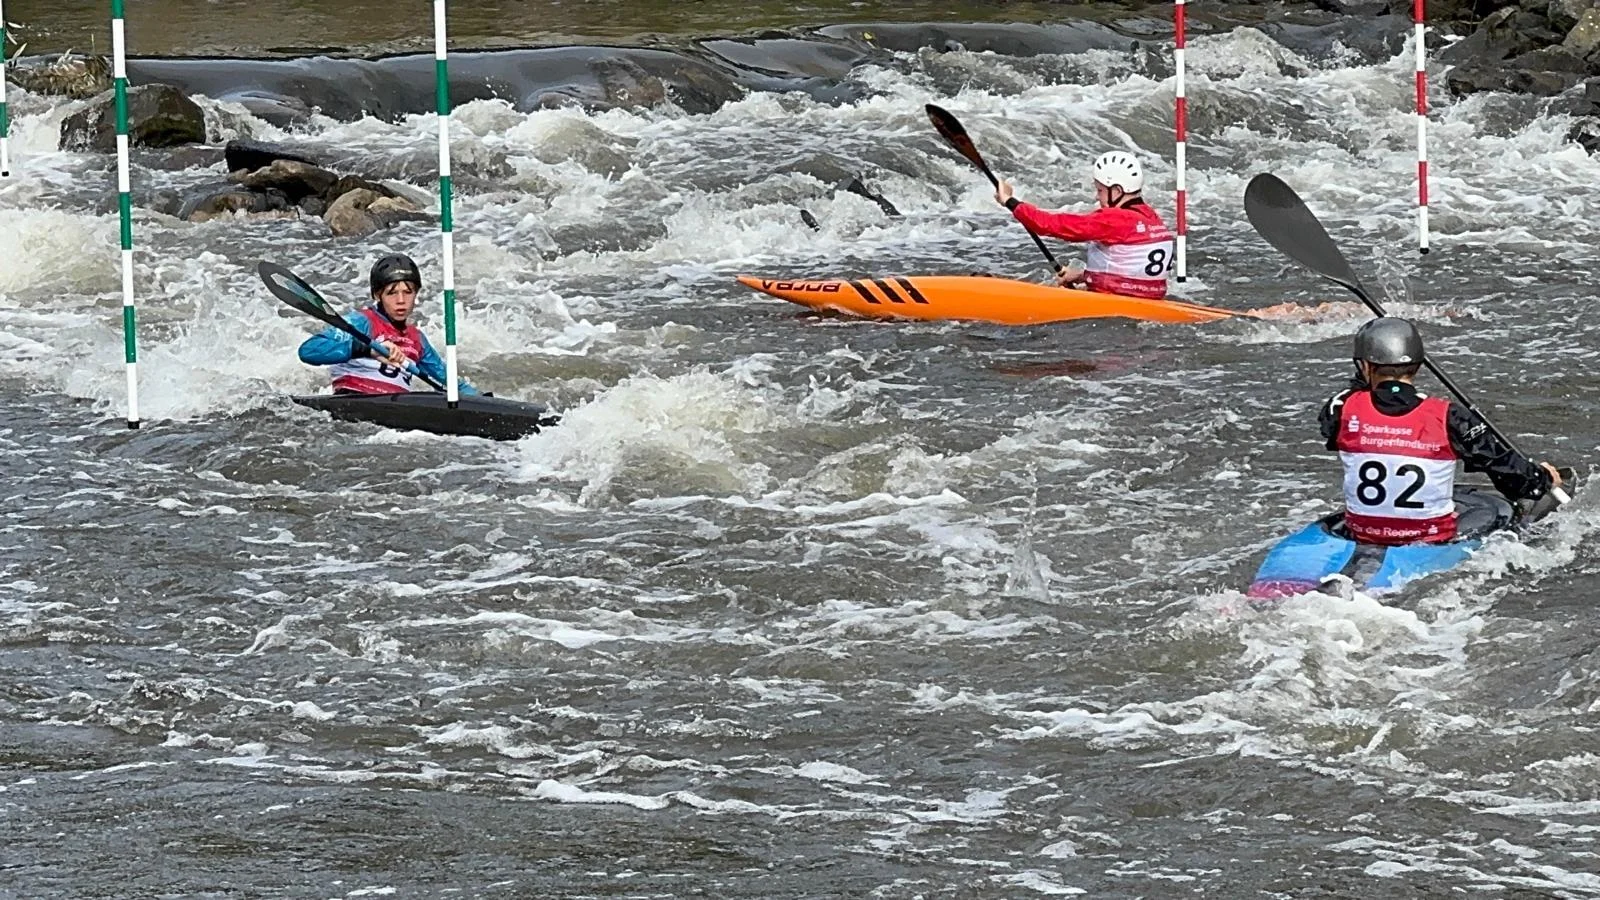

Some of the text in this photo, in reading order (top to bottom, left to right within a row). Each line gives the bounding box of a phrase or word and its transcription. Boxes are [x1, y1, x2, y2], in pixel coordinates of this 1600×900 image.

[1362, 423, 1413, 436] Sparkasse
[1360, 435, 1441, 452] Burgenlandkreis
[1356, 460, 1426, 509] 82
[1383, 527, 1422, 537] Region
